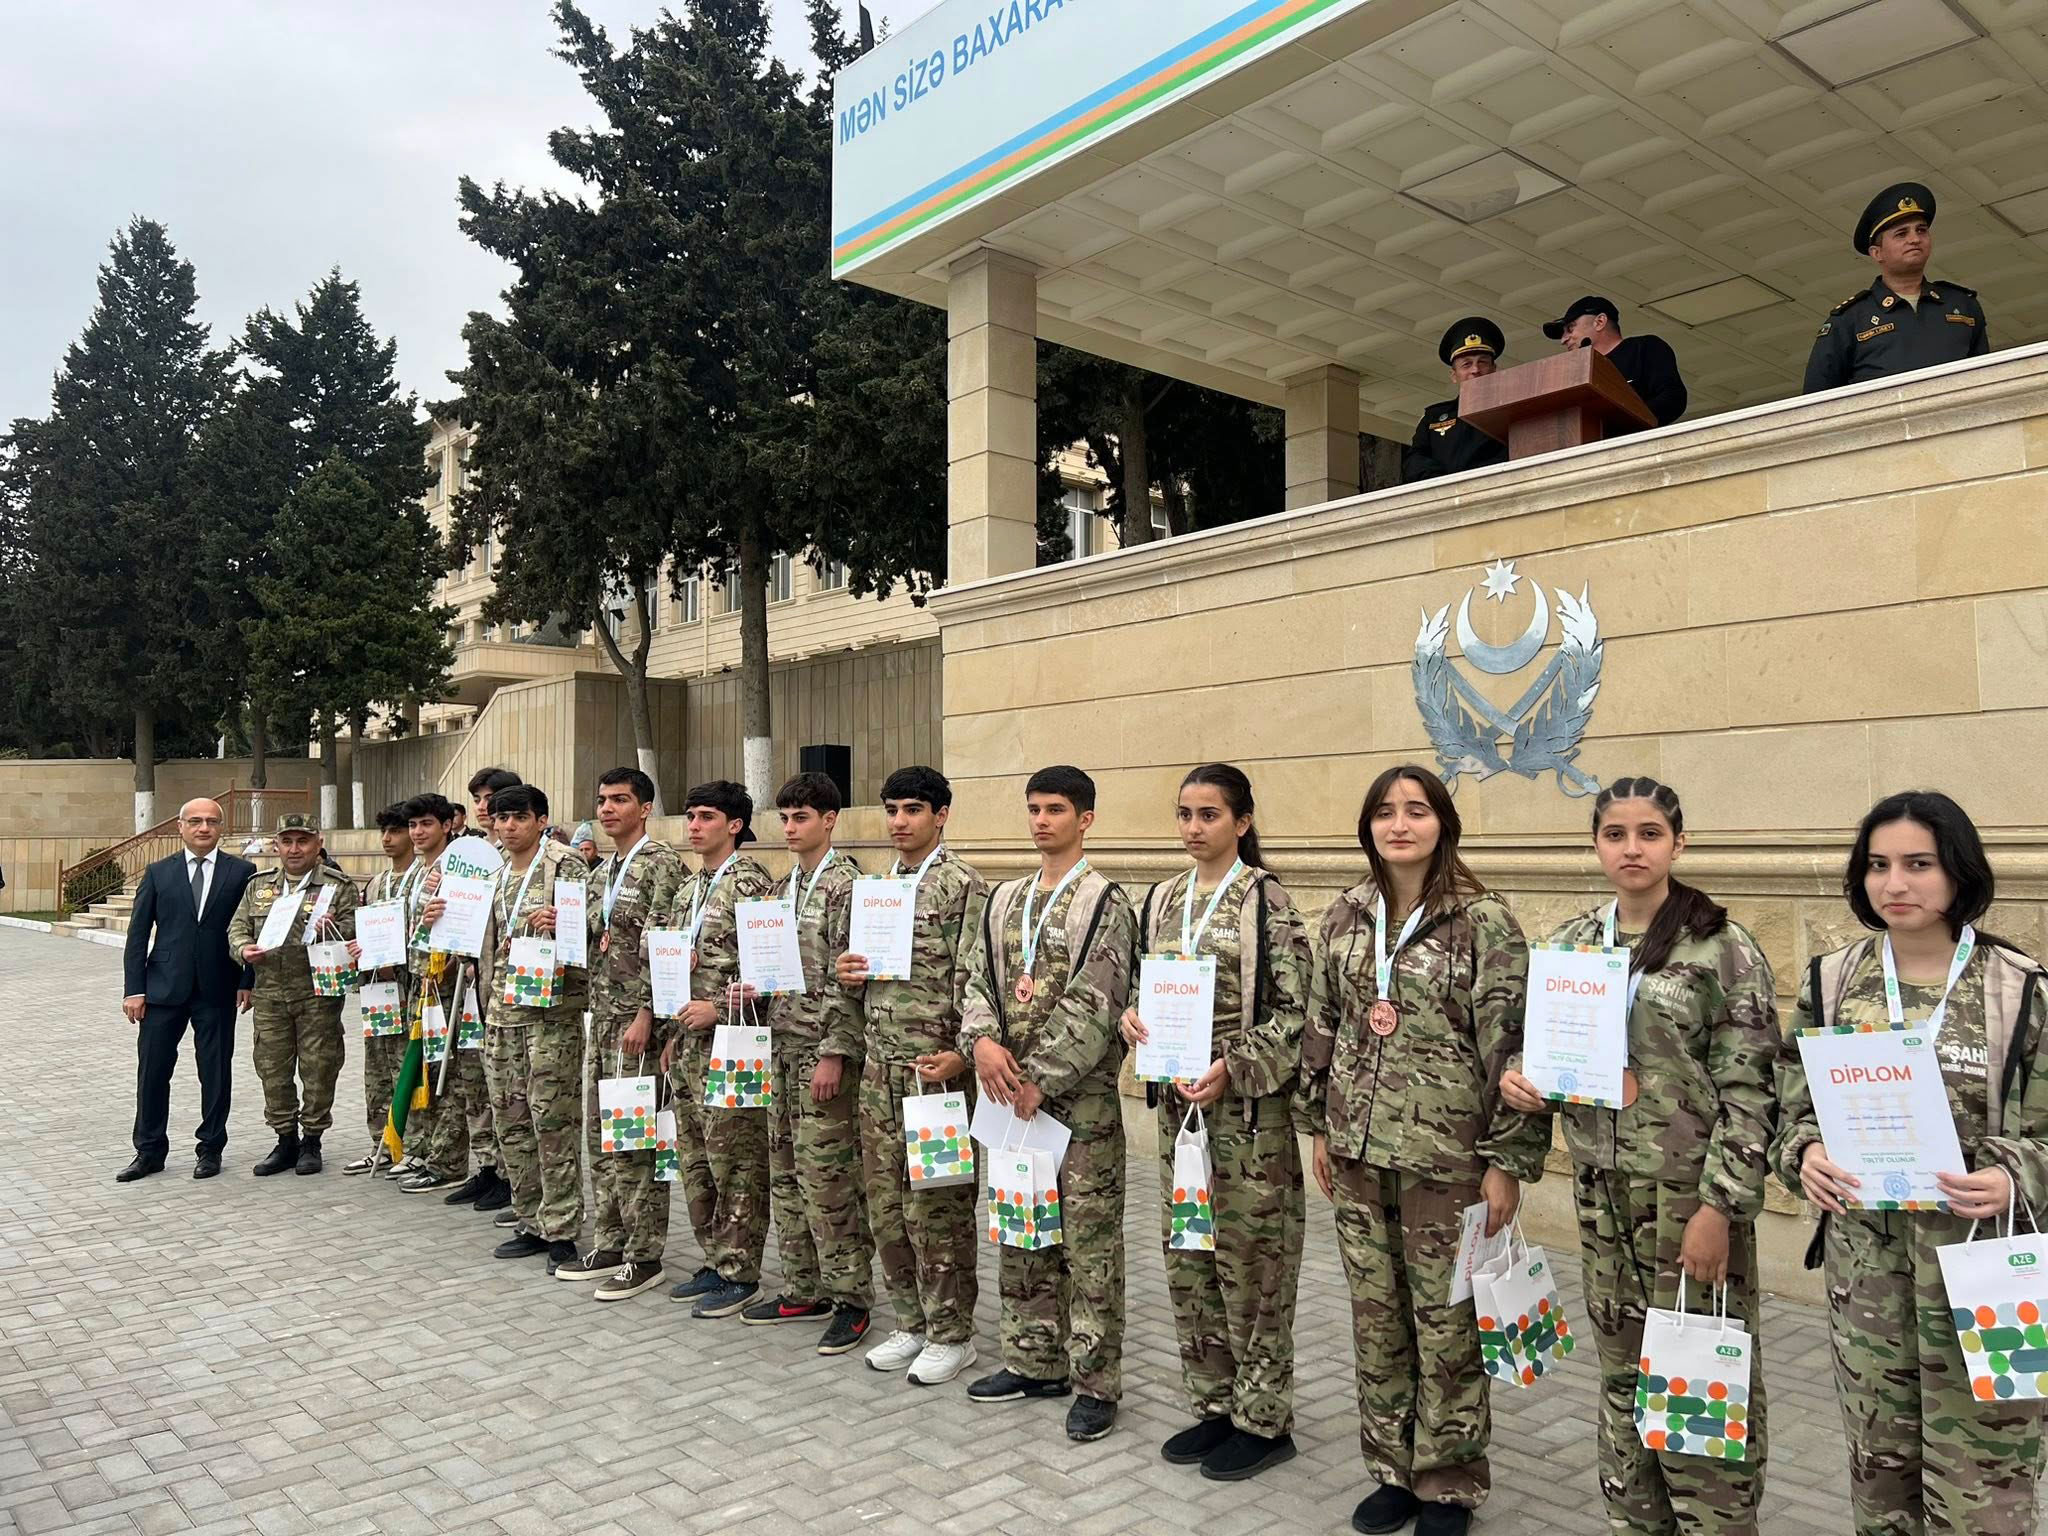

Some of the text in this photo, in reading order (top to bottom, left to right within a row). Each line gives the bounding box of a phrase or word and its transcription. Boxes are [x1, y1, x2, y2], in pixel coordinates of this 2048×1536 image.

[840, 86, 886, 145] MƏN
[893, 50, 945, 111] SİZƏ
[863, 896, 902, 908] DİPLOM
[747, 918, 784, 929] DİPLOM
[655, 946, 682, 956] DİPLOM
[1154, 980, 1199, 995] DİPLOM
[1546, 976, 1607, 996] DİPLOM
[1829, 1064, 1913, 1085] DİPLOM
[2013, 1254, 2032, 1265] AZE
[1719, 1346, 1738, 1356] AZE
